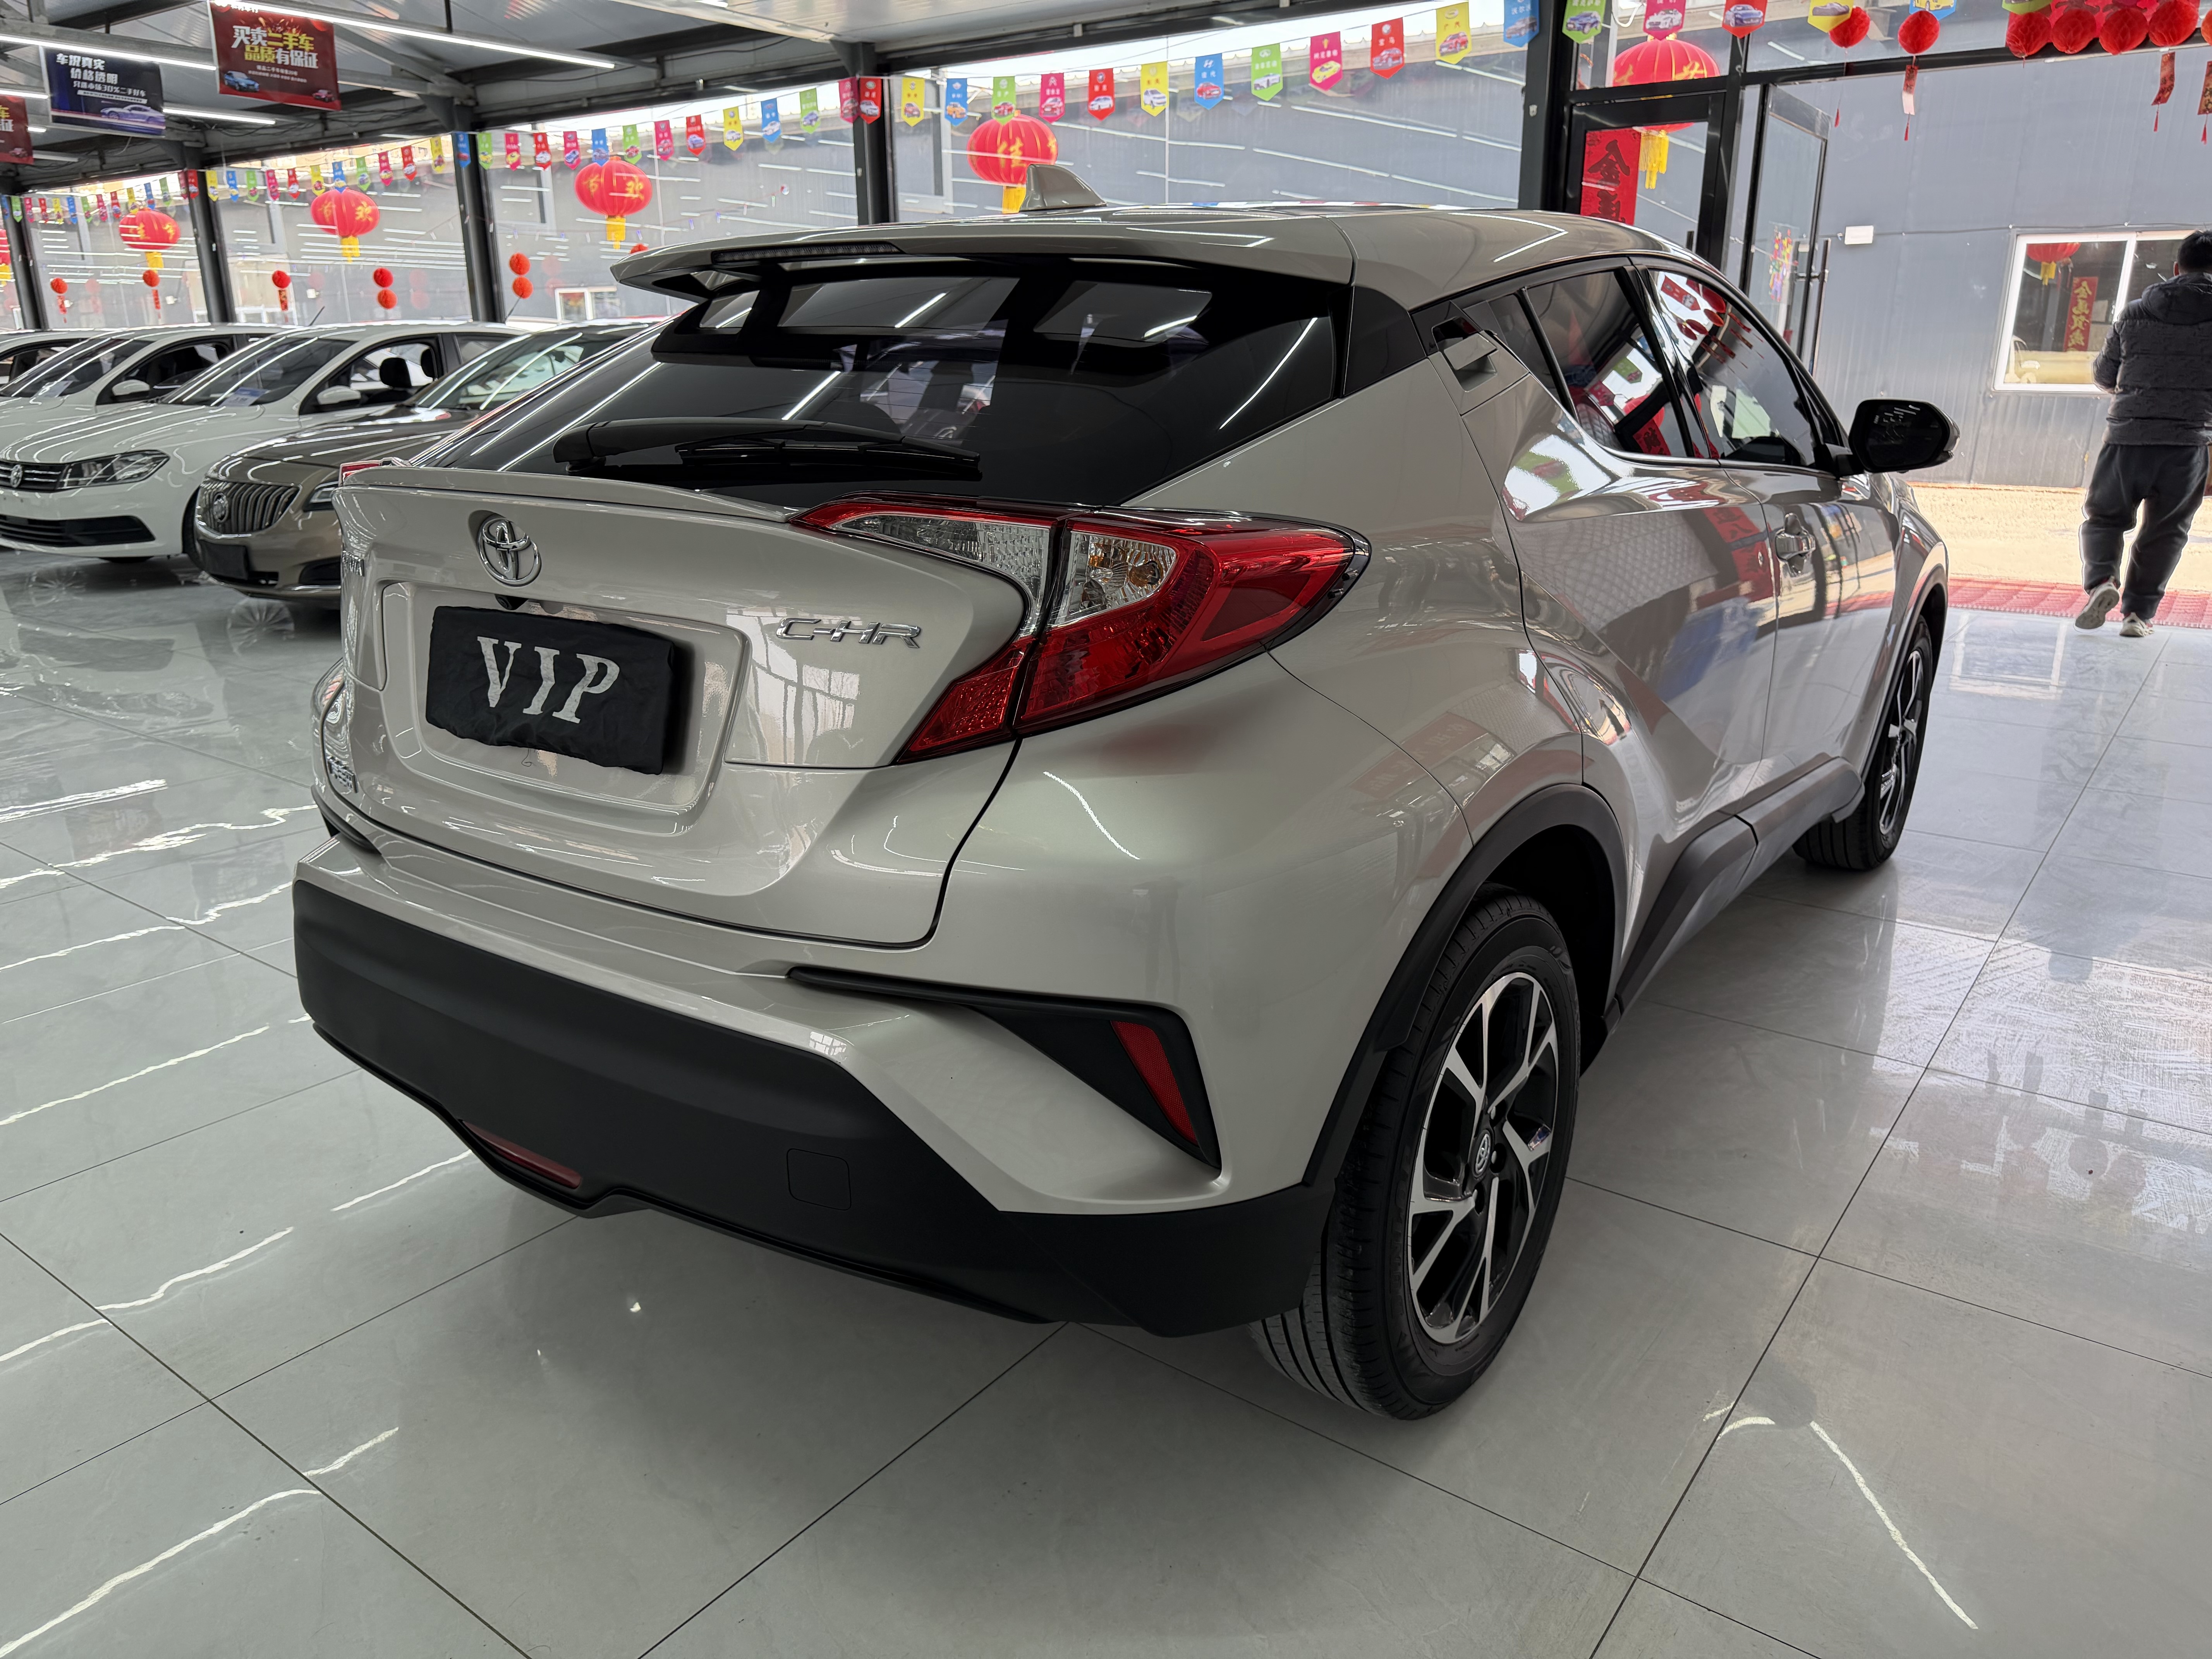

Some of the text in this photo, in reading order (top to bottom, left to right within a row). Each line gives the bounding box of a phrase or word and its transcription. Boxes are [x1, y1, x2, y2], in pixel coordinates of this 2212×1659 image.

[231, 25, 314, 51] 买卖二手车
[244, 45, 318, 69] 品质有保证
[776, 617, 922, 649] C-HR
[477, 636, 620, 724] VIP
